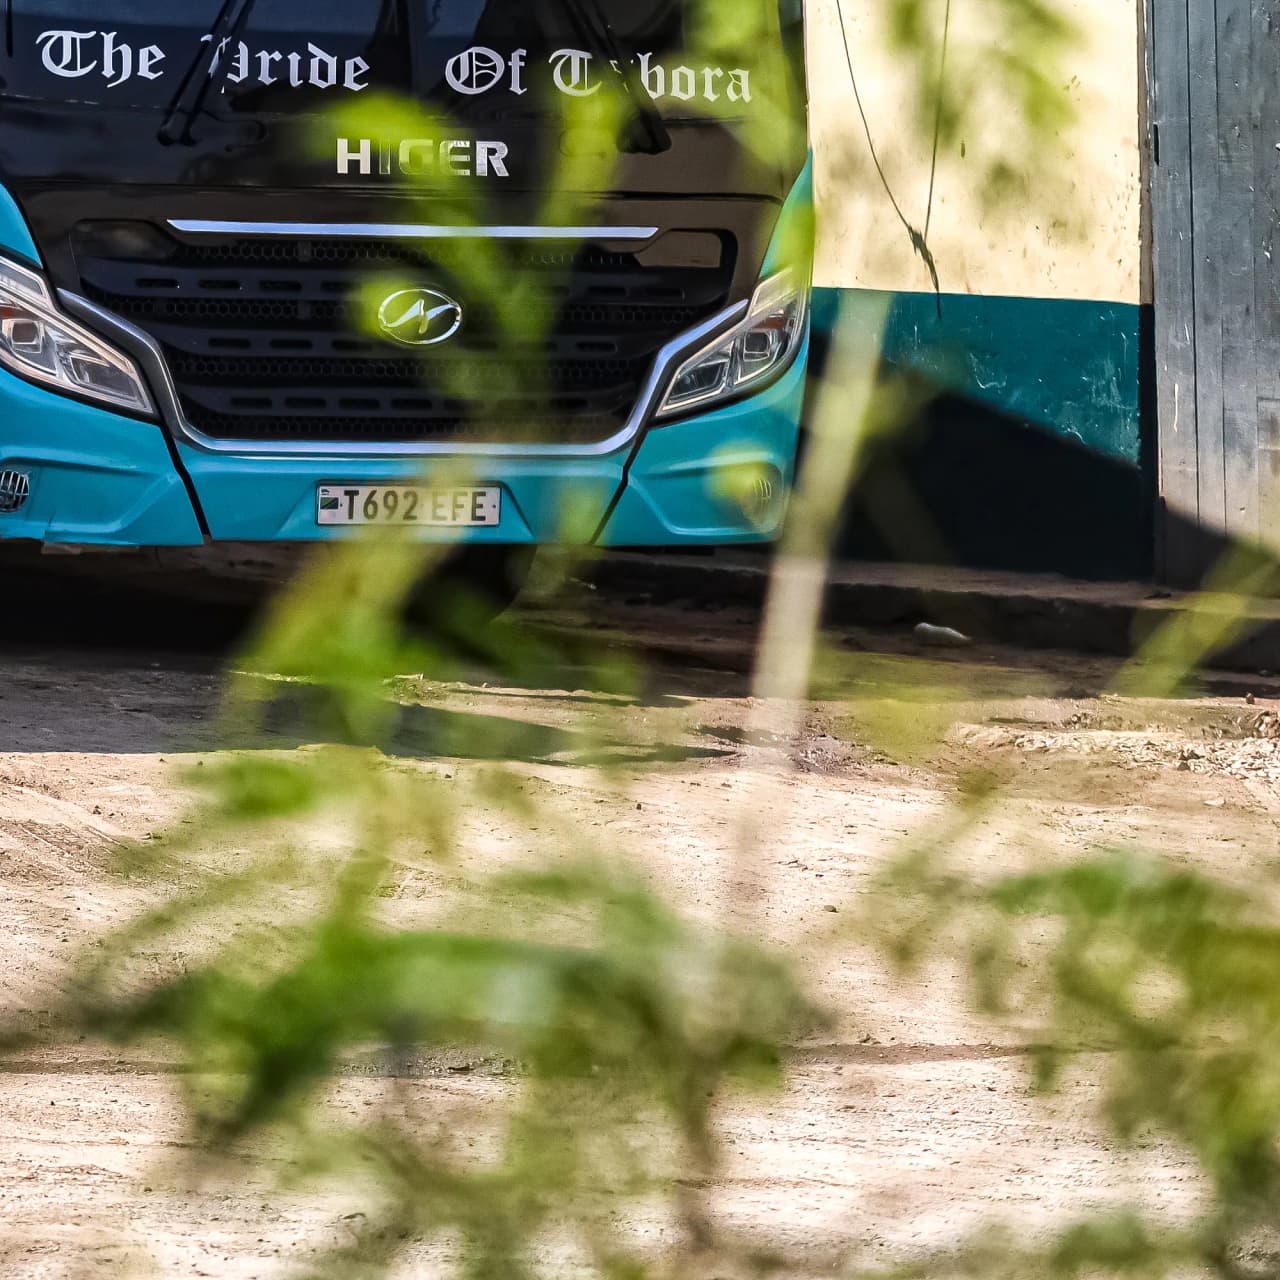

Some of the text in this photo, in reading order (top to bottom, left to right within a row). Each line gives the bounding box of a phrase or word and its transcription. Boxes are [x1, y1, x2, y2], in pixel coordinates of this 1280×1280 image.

[35, 30, 167, 88] The
[445, 46, 528, 95] Of
[548, 48, 753, 103] Tbora
[336, 137, 510, 177] HIGER
[343, 489, 487, 522] T692 EFE
